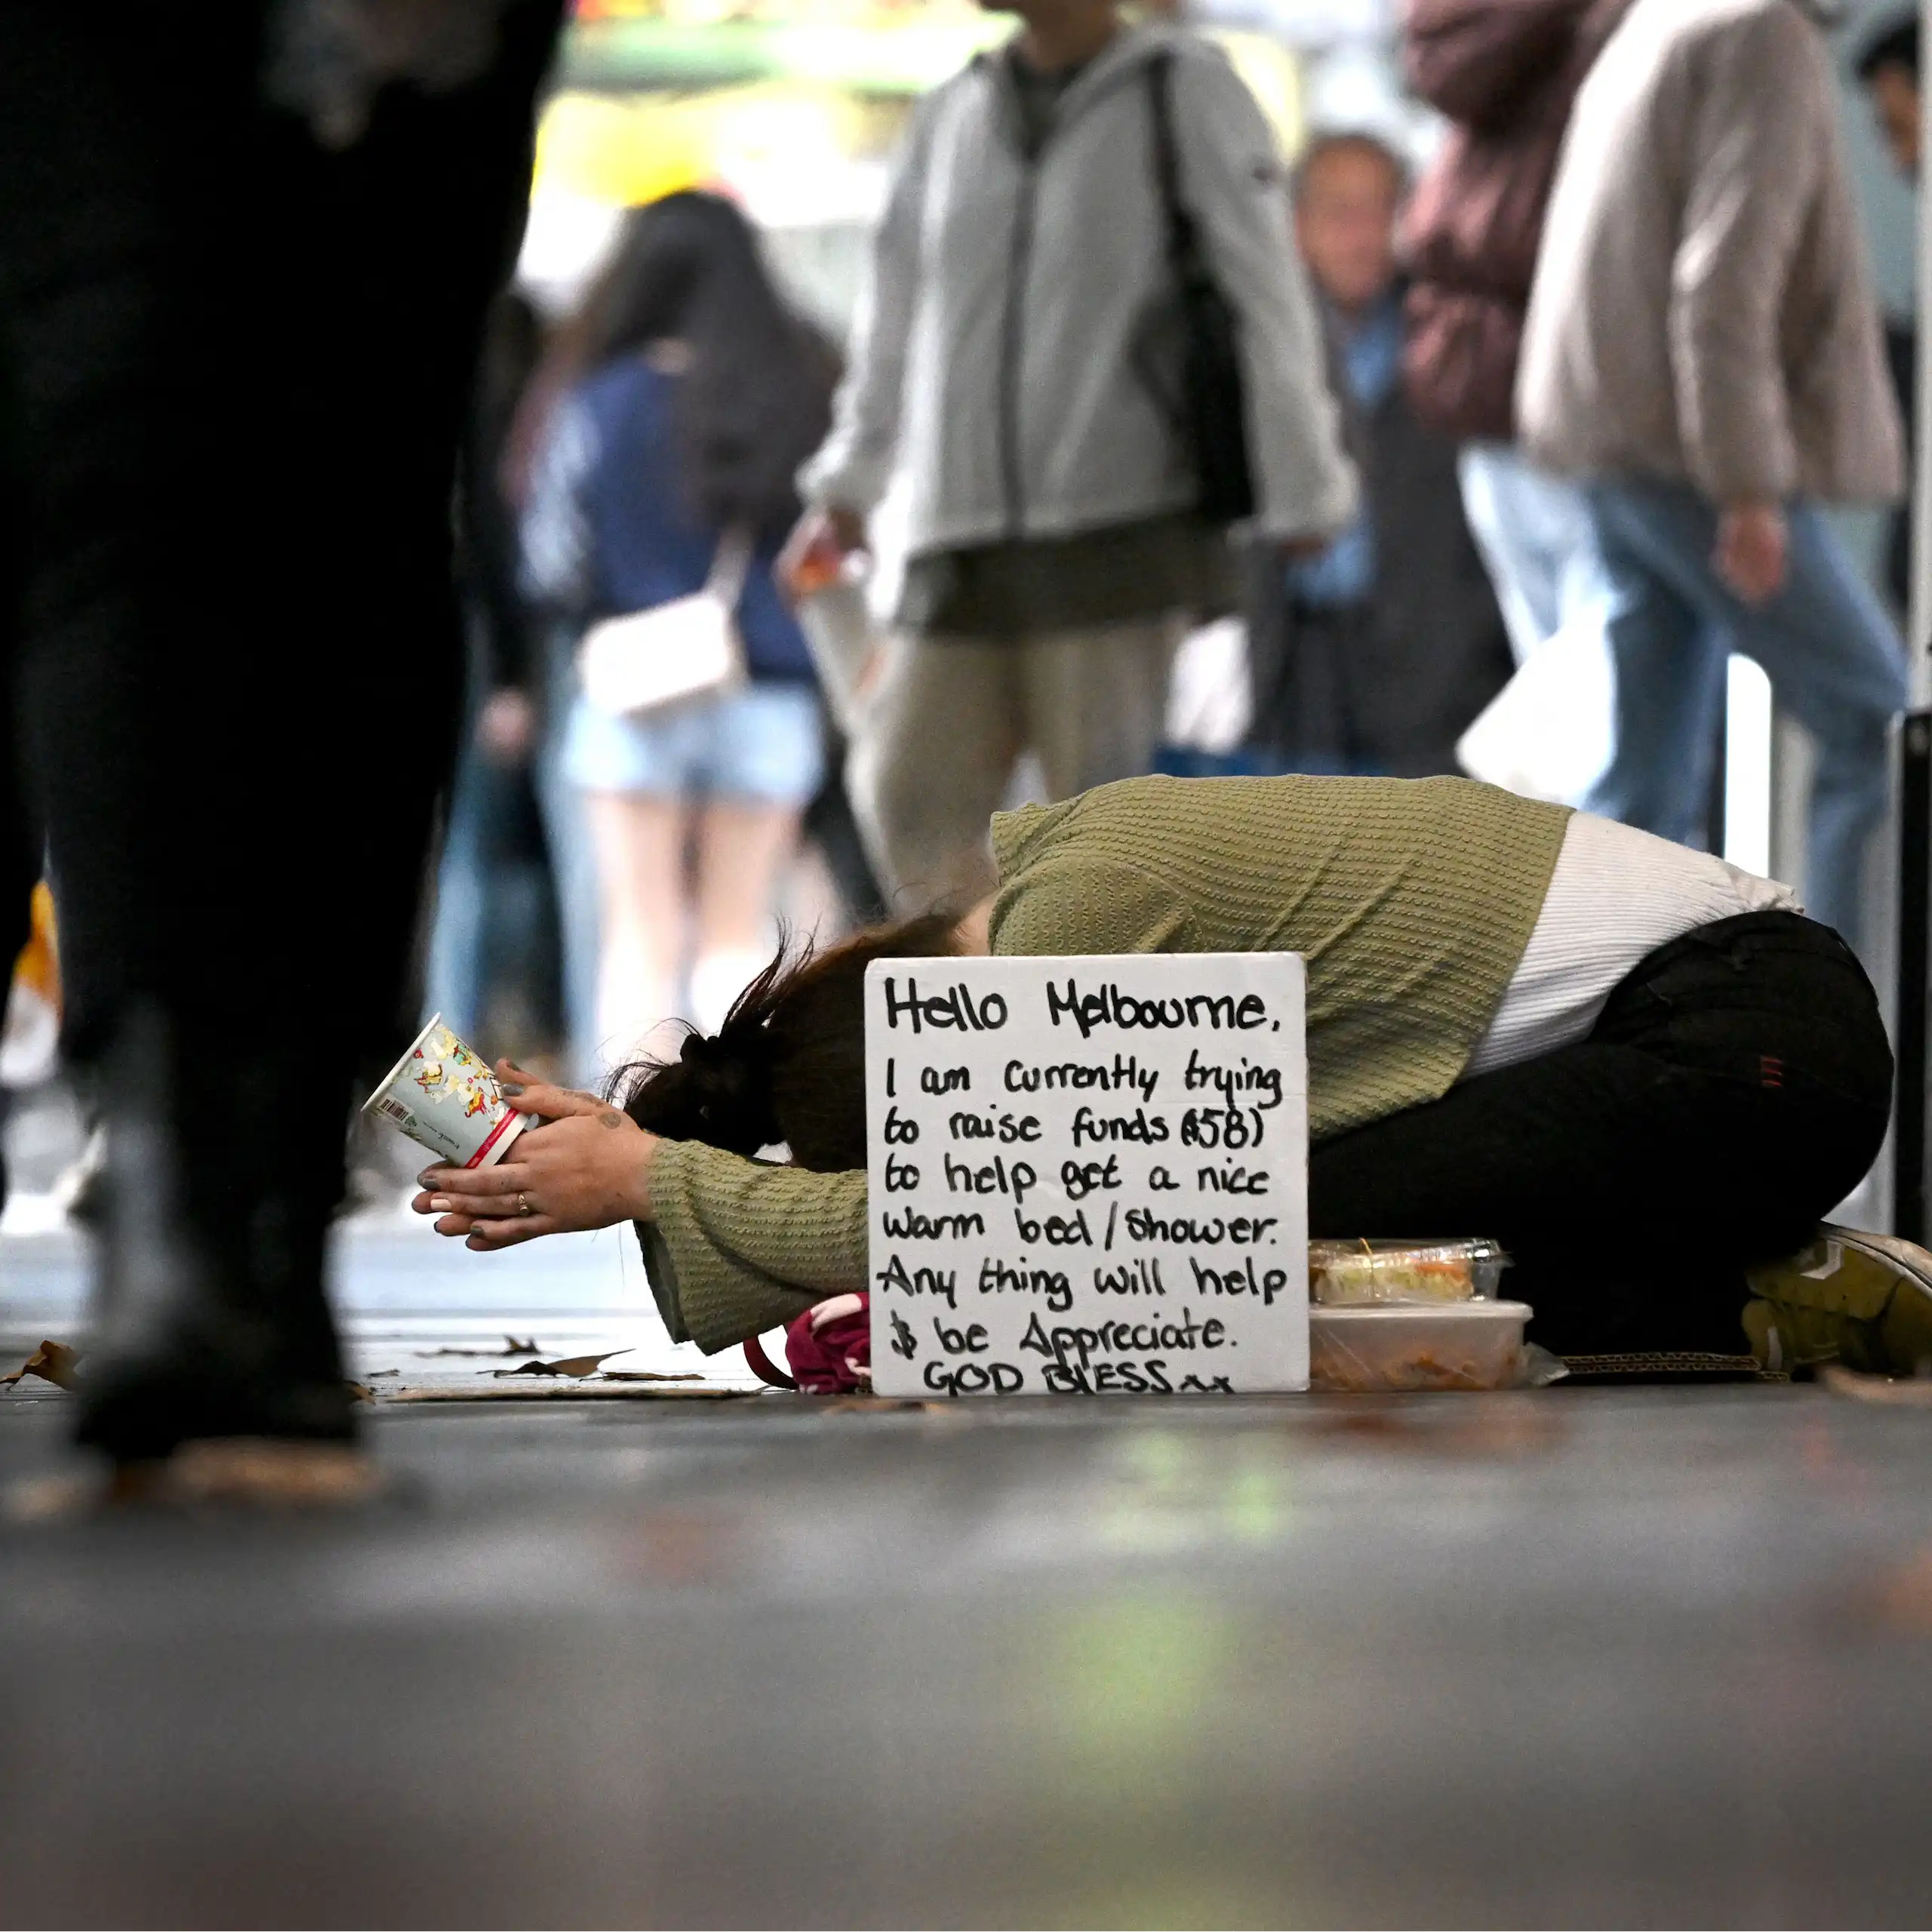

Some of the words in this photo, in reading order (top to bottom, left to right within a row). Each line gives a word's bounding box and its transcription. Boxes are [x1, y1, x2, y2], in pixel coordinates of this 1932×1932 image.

[884, 977, 1008, 1035] Hello
[887, 1058, 897, 1099] I
[921, 1066, 971, 1097] am
[1186, 1049, 1283, 1111] trying
[884, 1106, 920, 1146] to
[949, 1106, 1042, 1143] raise
[886, 1153, 921, 1193] to
[945, 1153, 1038, 1205] help
[1061, 1155, 1123, 1202] get
[1149, 1167, 1182, 1192] a
[1198, 1158, 1270, 1196] nice
[1094, 1259, 1167, 1297] will
[1190, 1257, 1288, 1306] help
[934, 1318, 990, 1355] be
[1018, 1306, 1236, 1371] Appreciate.
[924, 1361, 1024, 1396] GOD
